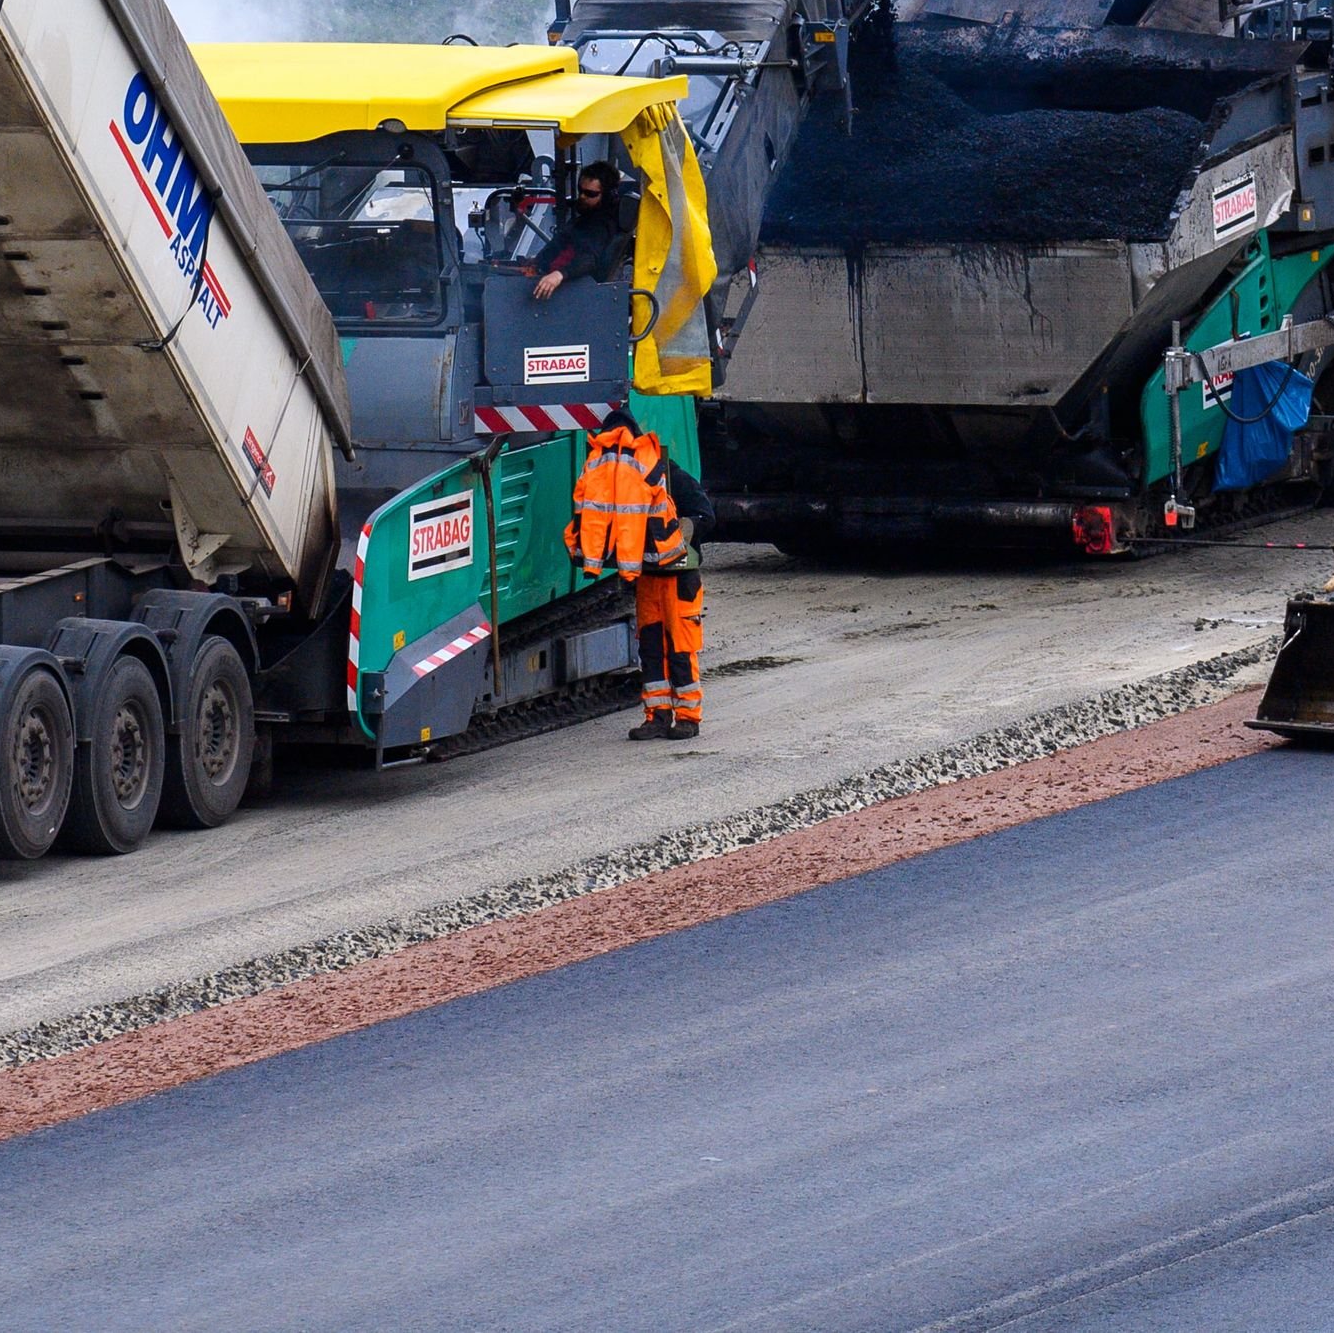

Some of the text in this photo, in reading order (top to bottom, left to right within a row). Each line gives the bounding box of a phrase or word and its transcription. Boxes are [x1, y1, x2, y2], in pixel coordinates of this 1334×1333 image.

[1215, 188, 1255, 224] STRABAG
[527, 357, 587, 372] STRABAG
[412, 514, 470, 556] STRABAG
